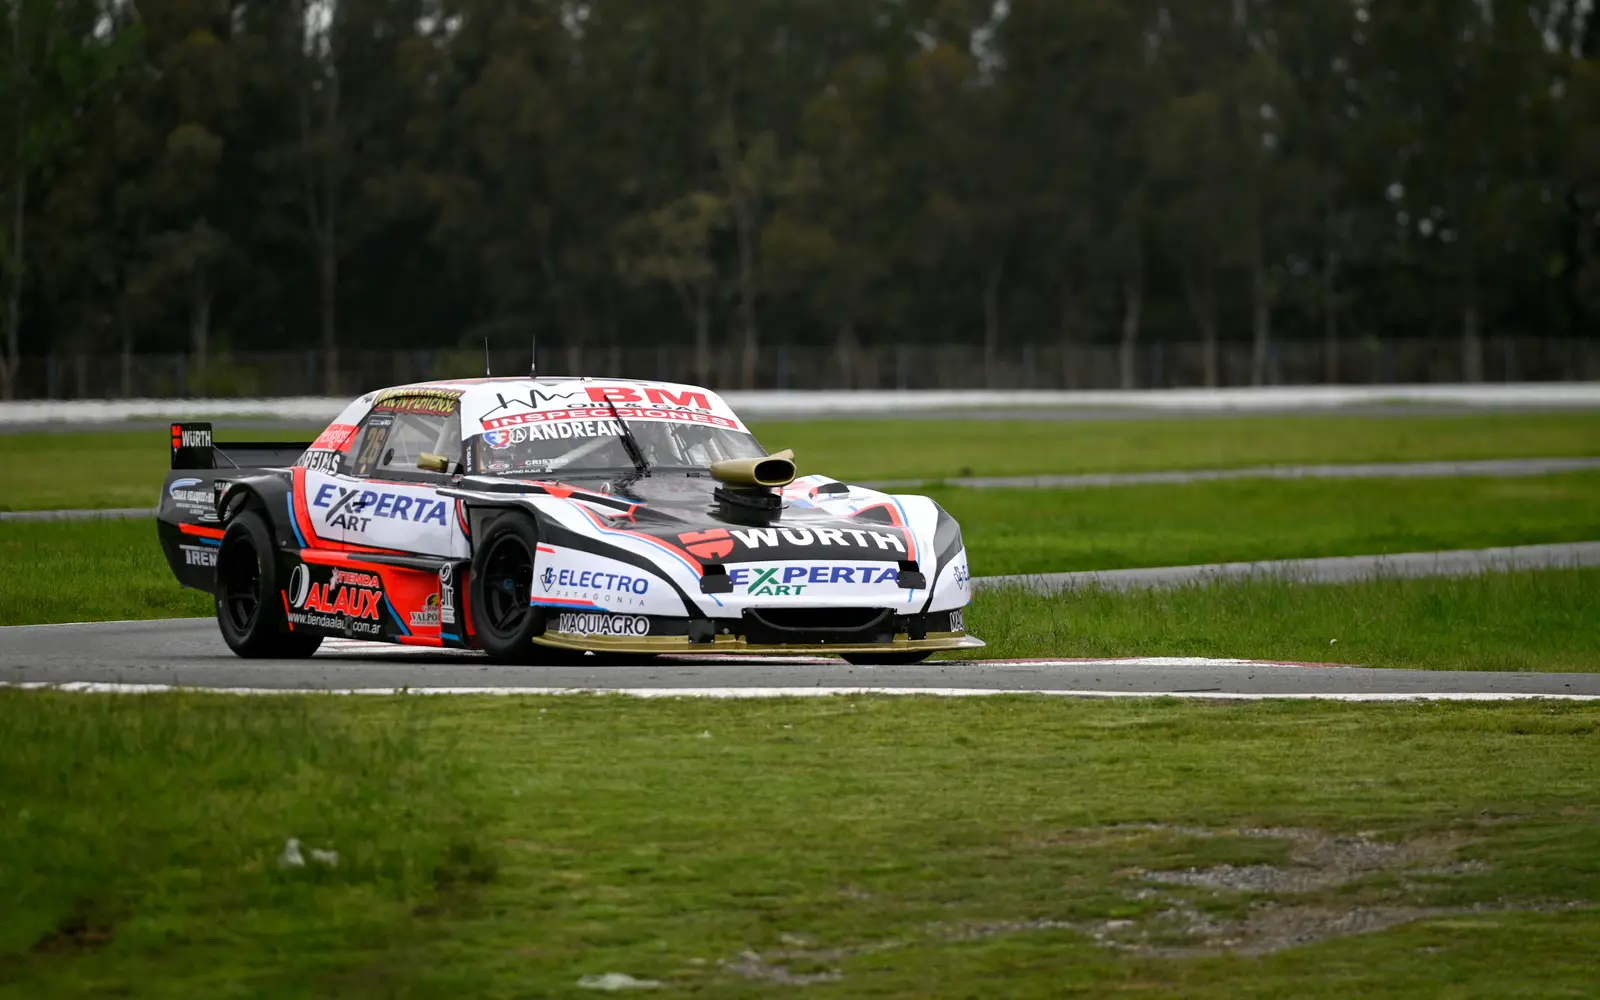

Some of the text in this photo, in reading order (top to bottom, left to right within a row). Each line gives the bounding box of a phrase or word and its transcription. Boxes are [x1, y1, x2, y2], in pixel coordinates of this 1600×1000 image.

[585, 387, 712, 411] BM
[652, 404, 711, 415] GAS
[491, 407, 730, 428] INSPECCIONES
[313, 483, 447, 526] EXPERTA
[330, 513, 372, 532] ART
[730, 526, 907, 553] WÜRTH
[338, 571, 380, 588] TIENDA
[558, 569, 649, 595] ELECTRO
[729, 566, 898, 592] EXPERTA
[304, 582, 382, 619] ALAUX
[556, 590, 645, 607] PATAGONIA
[755, 585, 808, 596] ART
[288, 612, 381, 634] www.tiendaalaucom.ar
[559, 613, 650, 636] MAQUIAGRO
